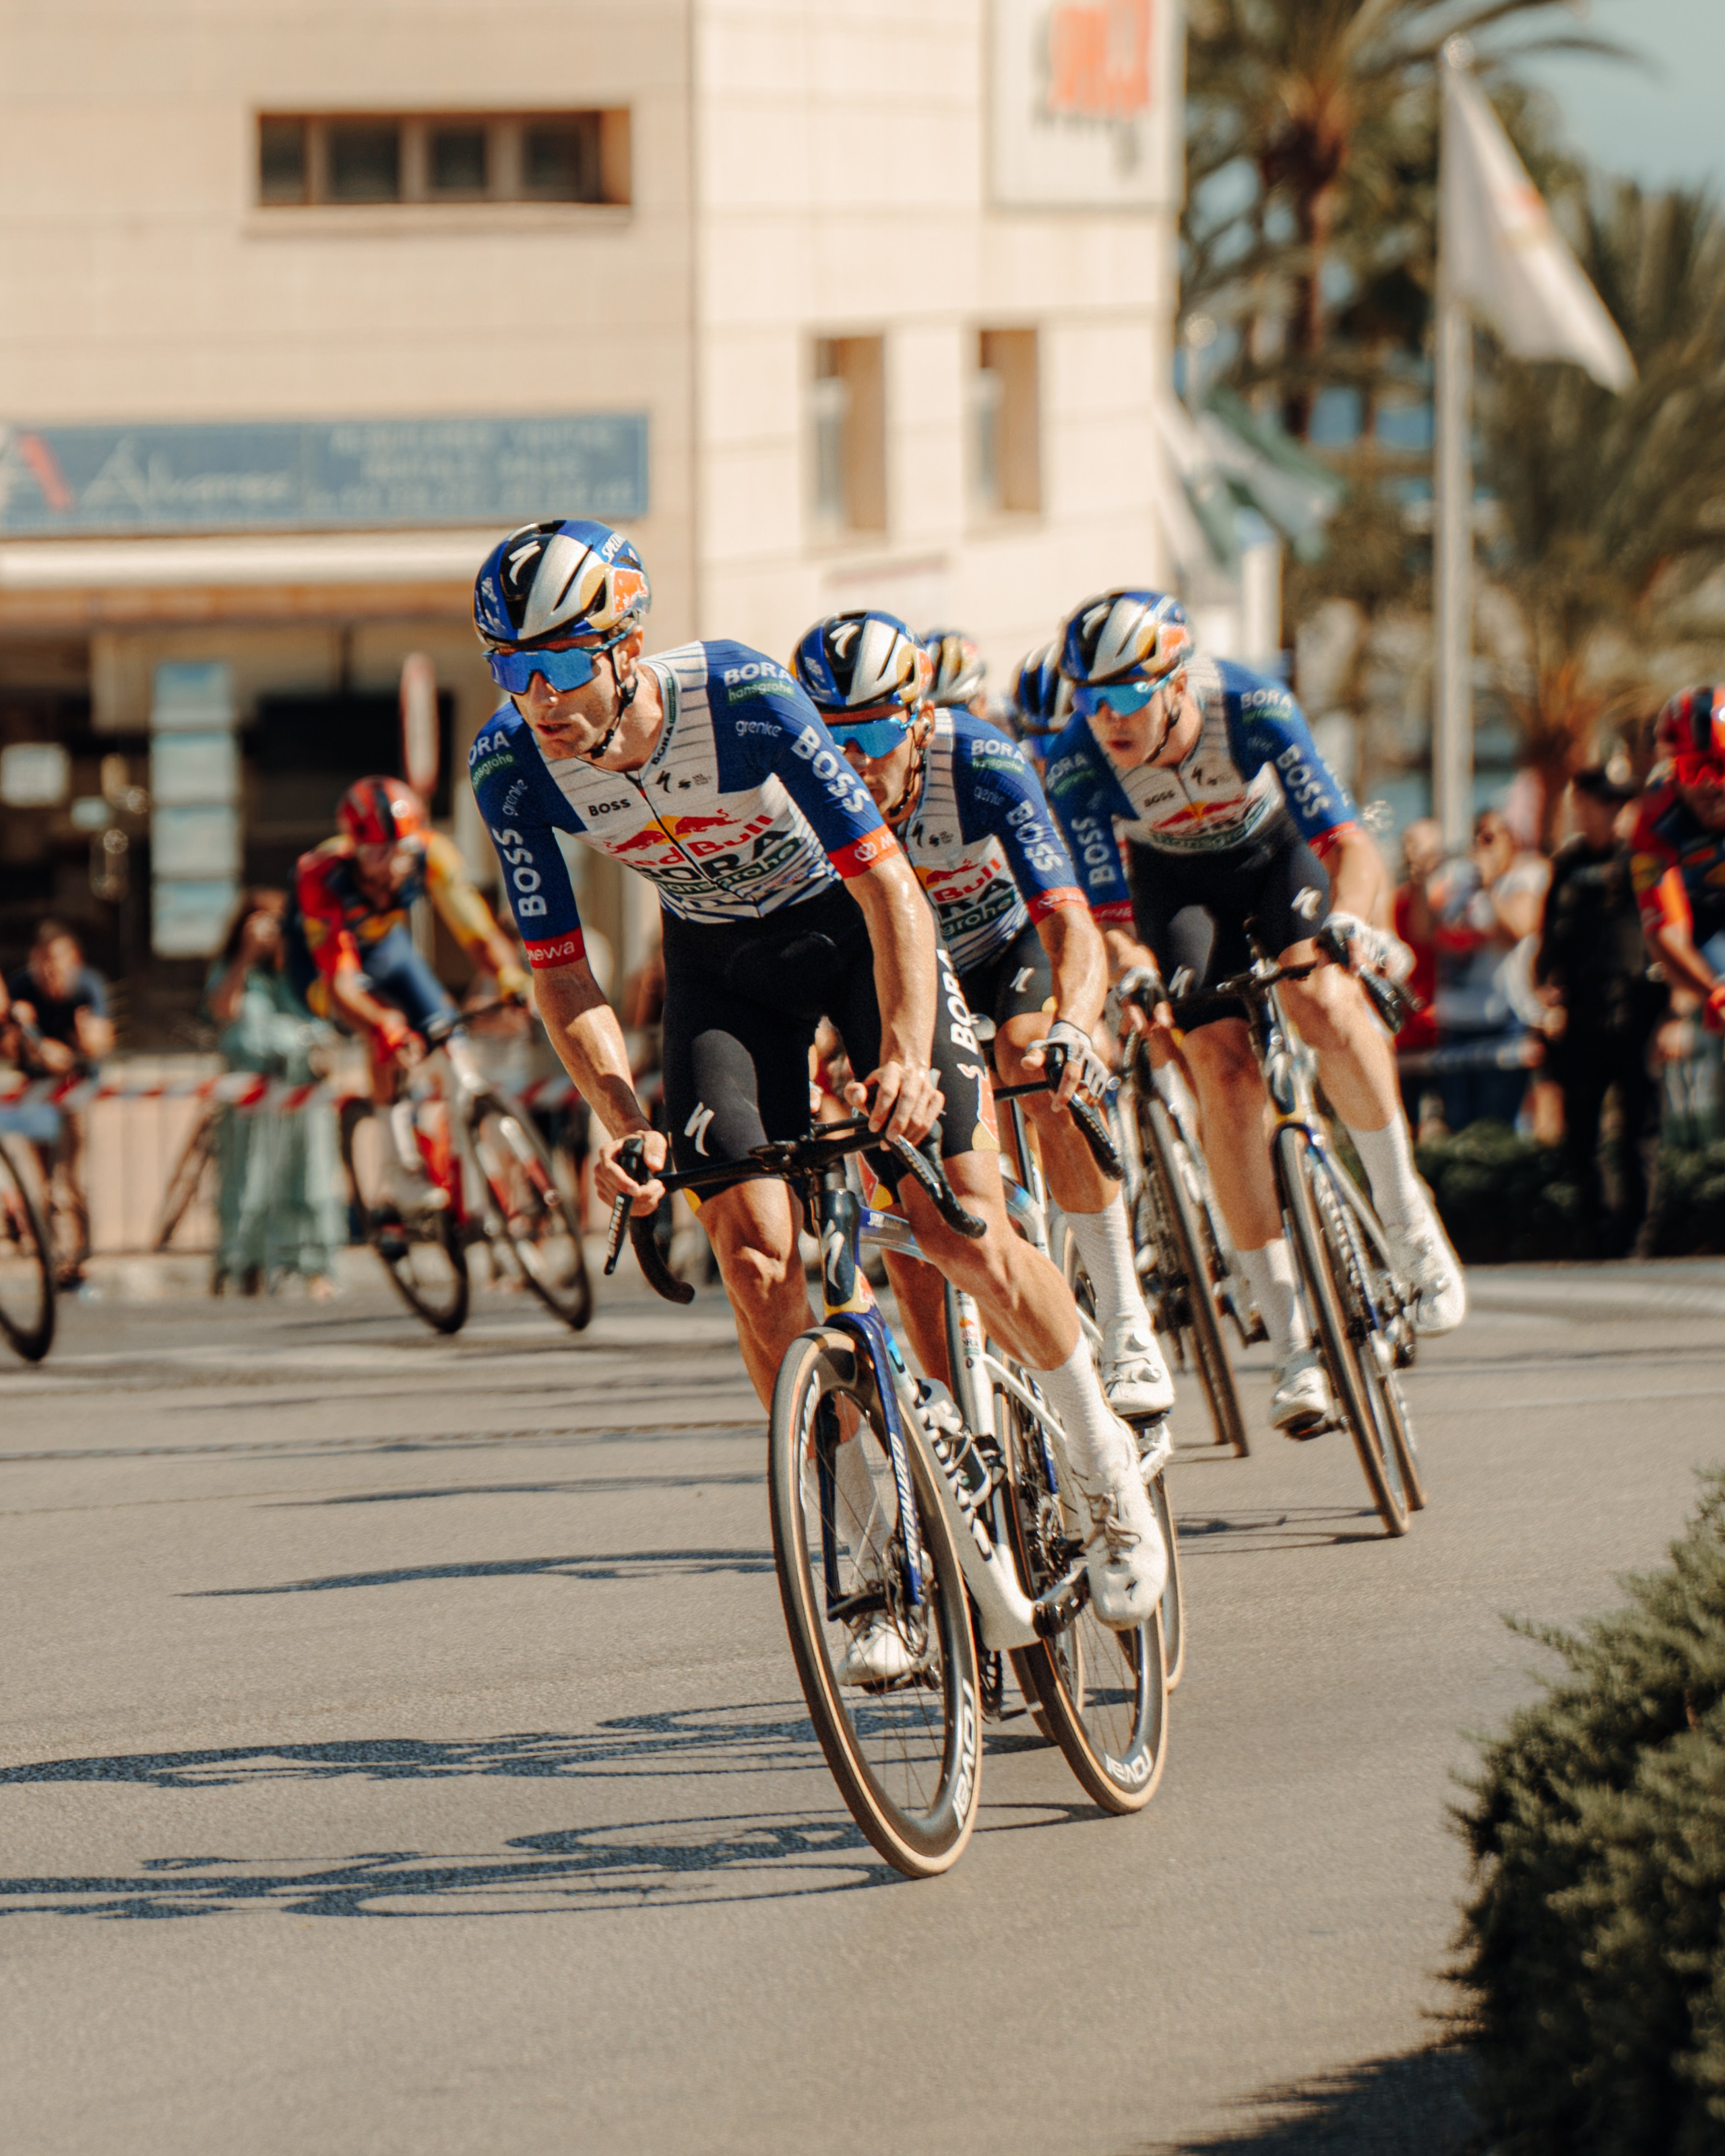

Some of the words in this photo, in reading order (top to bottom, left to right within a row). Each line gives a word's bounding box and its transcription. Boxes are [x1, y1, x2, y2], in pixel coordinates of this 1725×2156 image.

[724, 661, 795, 687] BORA
[728, 678, 794, 700] hansgrohe
[1241, 689, 1292, 709] BORA
[735, 719, 782, 737] grenke
[468, 730, 510, 766] ORA
[971, 738, 1026, 765] BORA
[472, 753, 514, 787] ansgrohe
[790, 725, 871, 813] BOSS
[1046, 752, 1089, 790] BORA
[1276, 743, 1331, 818] BOSS
[588, 798, 631, 817] BOSS
[608, 846, 685, 866] ed
[687, 814, 774, 858] Bull
[624, 830, 792, 879] BORA
[1005, 799, 1064, 871] BOSS
[1071, 816, 1115, 886] BOSS
[491, 827, 547, 917] BOSS
[932, 857, 1001, 902] Bull
[937, 877, 1014, 920] RA
[942, 897, 1012, 936] grohe
